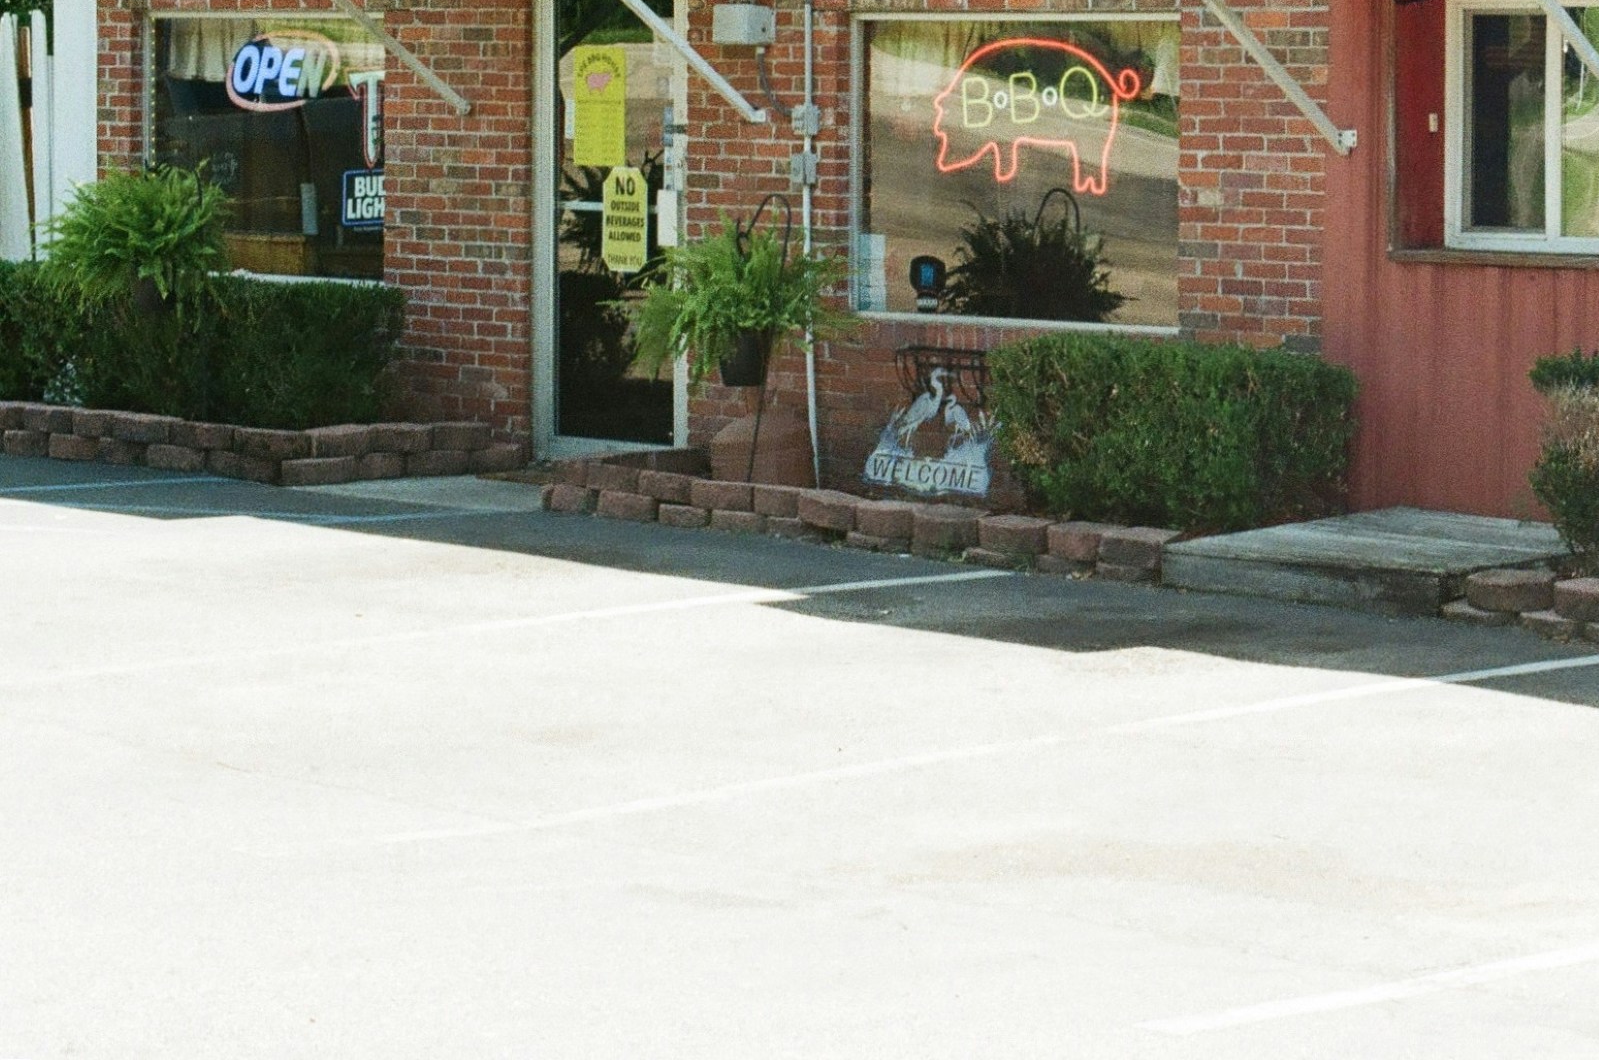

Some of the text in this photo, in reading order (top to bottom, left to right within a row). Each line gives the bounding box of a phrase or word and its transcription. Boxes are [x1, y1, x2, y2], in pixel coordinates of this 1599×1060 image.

[232, 43, 328, 99] OPEN
[615, 176, 636, 196] NO
[347, 197, 386, 219] LIGH
[610, 200, 640, 213] OUTSIDE
[606, 214, 644, 228] BEVERAGES
[608, 231, 641, 243] ALLOWED
[873, 458, 981, 490] WELCOME
